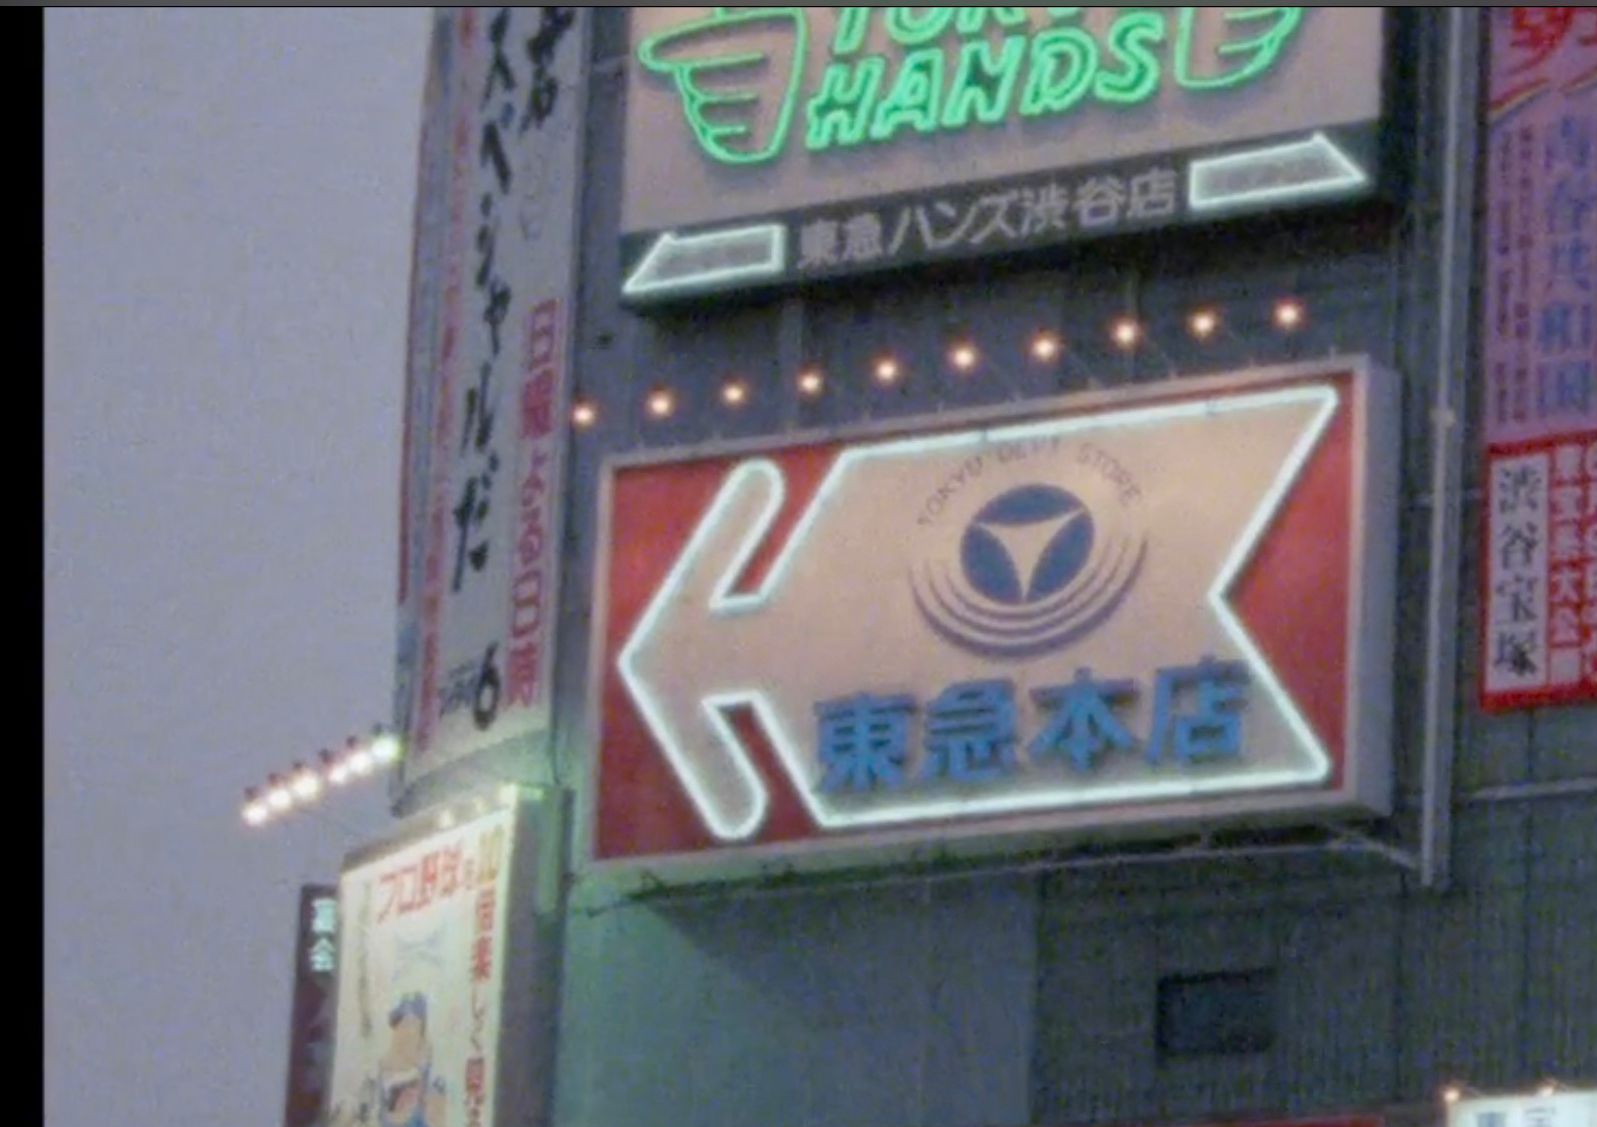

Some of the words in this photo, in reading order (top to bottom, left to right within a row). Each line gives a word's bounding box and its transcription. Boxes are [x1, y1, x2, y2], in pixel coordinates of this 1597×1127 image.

[807, 12, 1166, 150] HANDS
[797, 170, 1178, 270] 東急ハンズ渋谷店
[814, 655, 1252, 795] 東急本店
